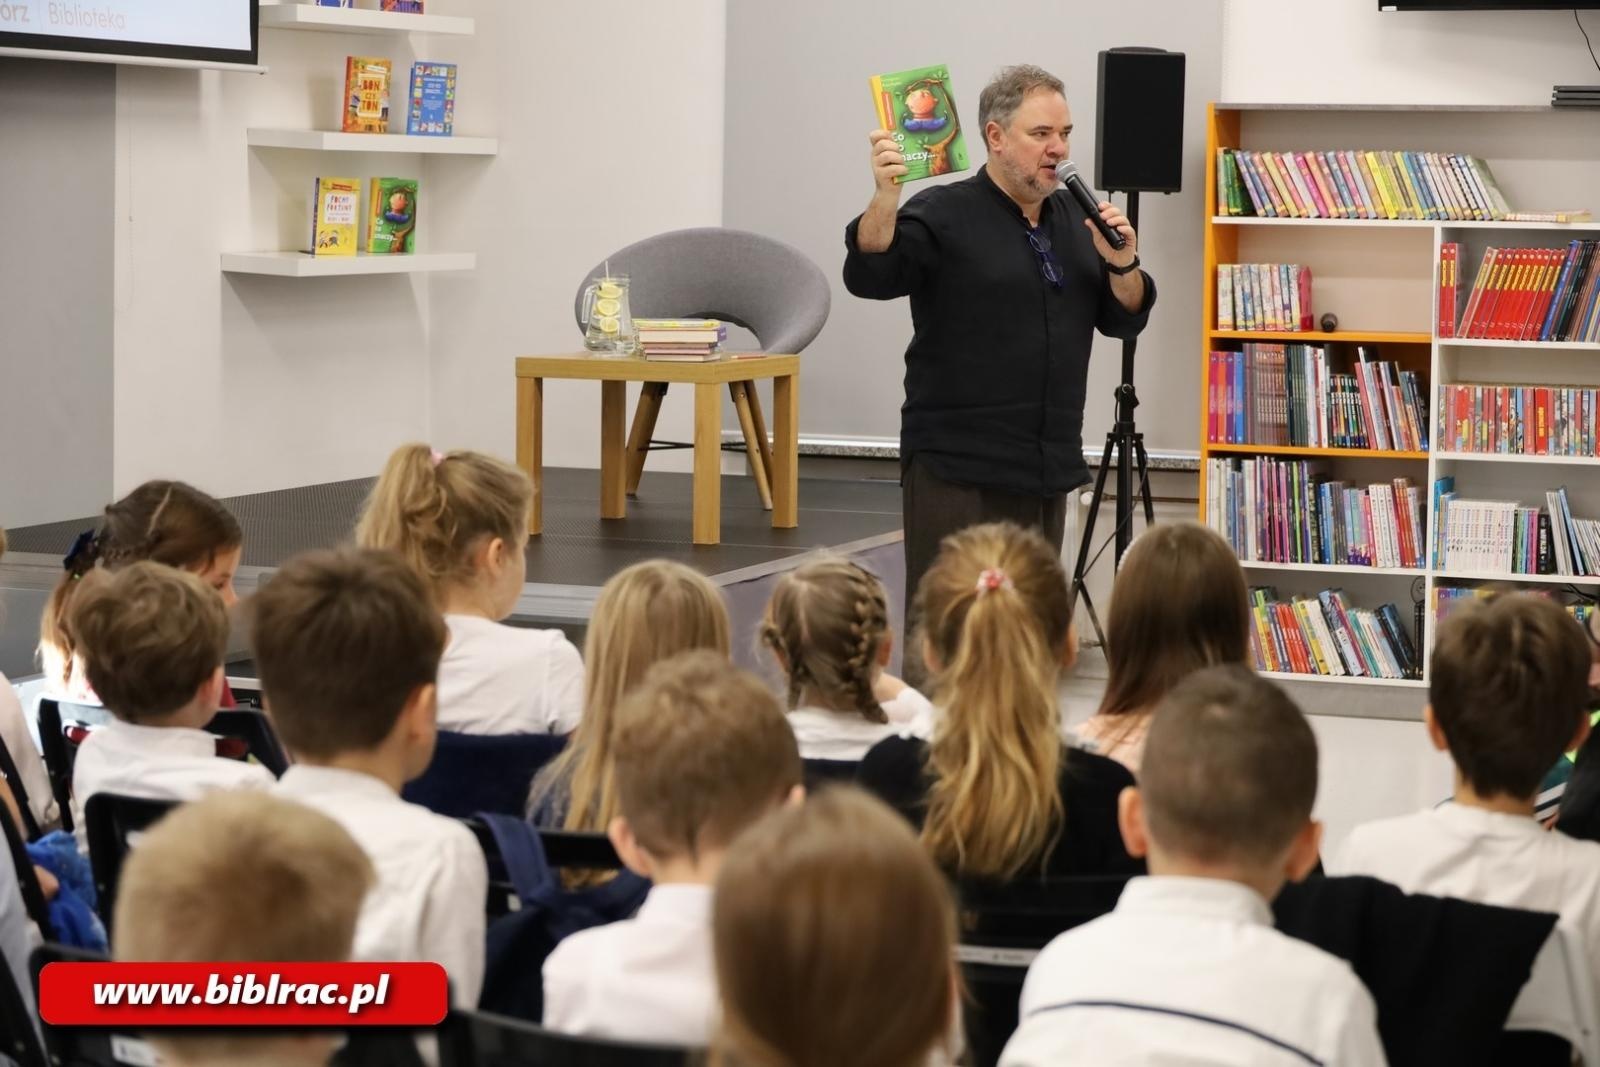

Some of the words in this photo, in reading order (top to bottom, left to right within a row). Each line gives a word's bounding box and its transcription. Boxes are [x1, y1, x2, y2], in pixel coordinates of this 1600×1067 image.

[48, 2, 127, 30] Biblioteka
[363, 80, 380, 91] BON
[362, 100, 378, 111] TON
[891, 132, 904, 142] Co
